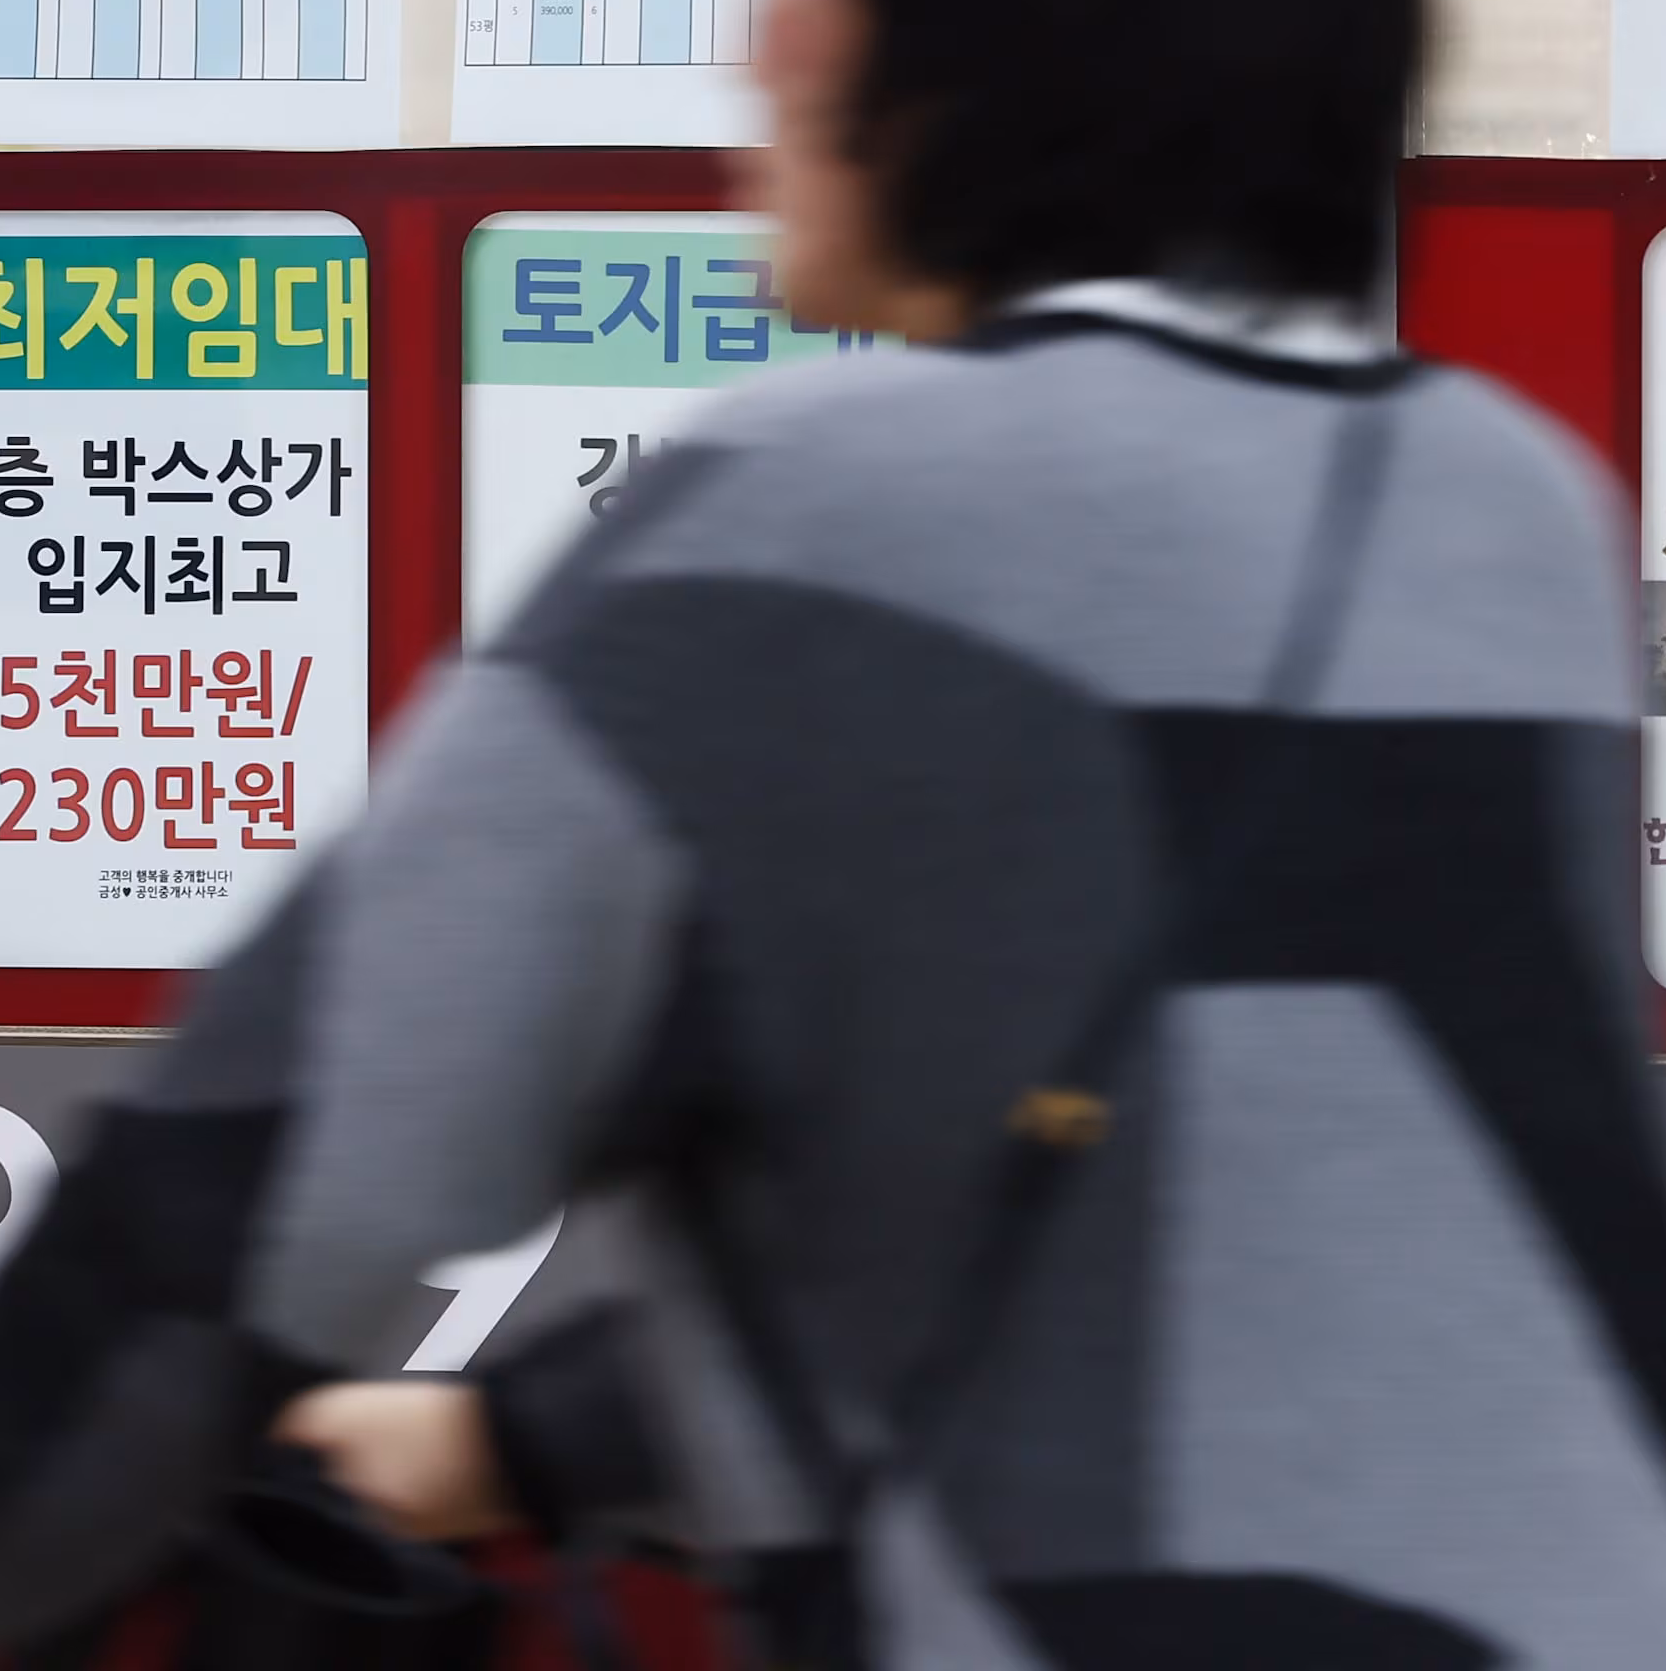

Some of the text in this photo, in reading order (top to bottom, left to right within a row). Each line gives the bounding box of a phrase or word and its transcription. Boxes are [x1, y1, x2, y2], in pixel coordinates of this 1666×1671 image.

[503, 256, 875, 362] 토지급
[84, 438, 351, 516] 박스상가
[28, 536, 297, 615] 입지최고
[1, 650, 312, 738] 5천만원/
